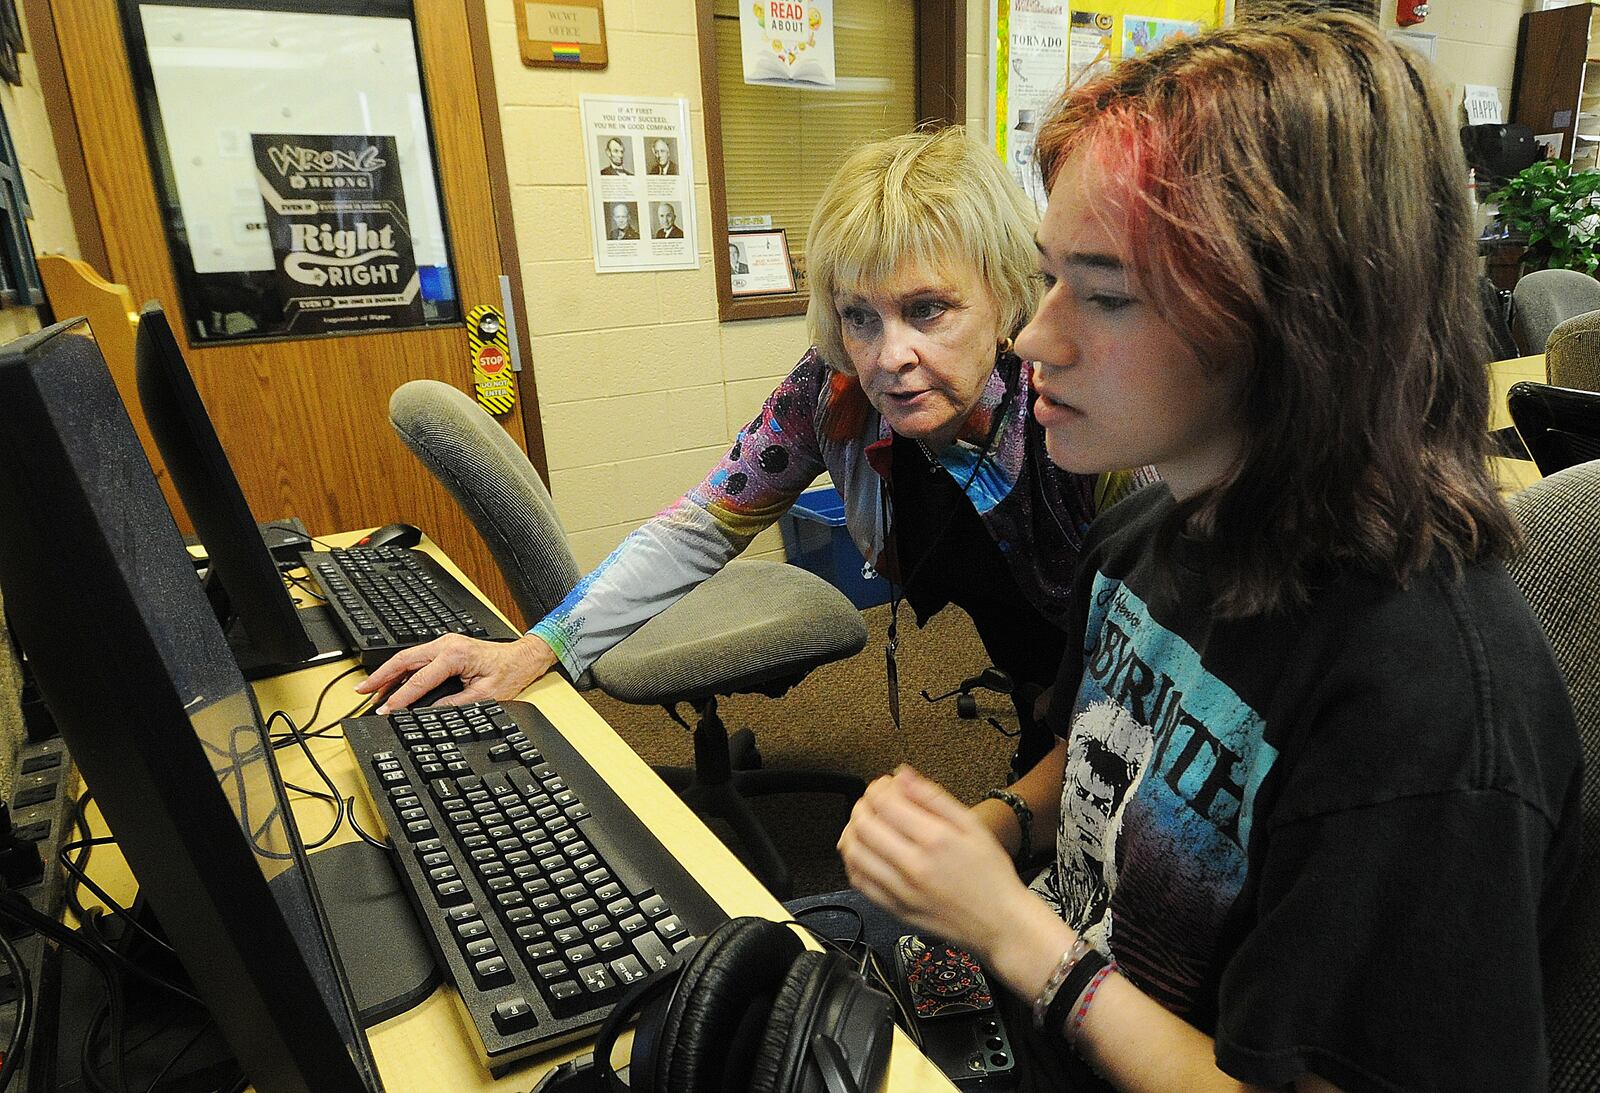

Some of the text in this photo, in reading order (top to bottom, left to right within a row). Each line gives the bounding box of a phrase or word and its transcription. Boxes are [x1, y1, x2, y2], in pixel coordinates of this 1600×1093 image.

[770, 1, 803, 20] READ
[771, 20, 803, 32] ABOUT
[1011, 34, 1062, 48] TORNADO
[1471, 99, 1498, 119] HAPPY
[267, 144, 387, 176] WRONG
[308, 176, 368, 188] WRONG
[290, 222, 395, 258] Right
[327, 264, 400, 287] RIGHT
[480, 355, 503, 366] STOP
[485, 389, 507, 397] ENTER
